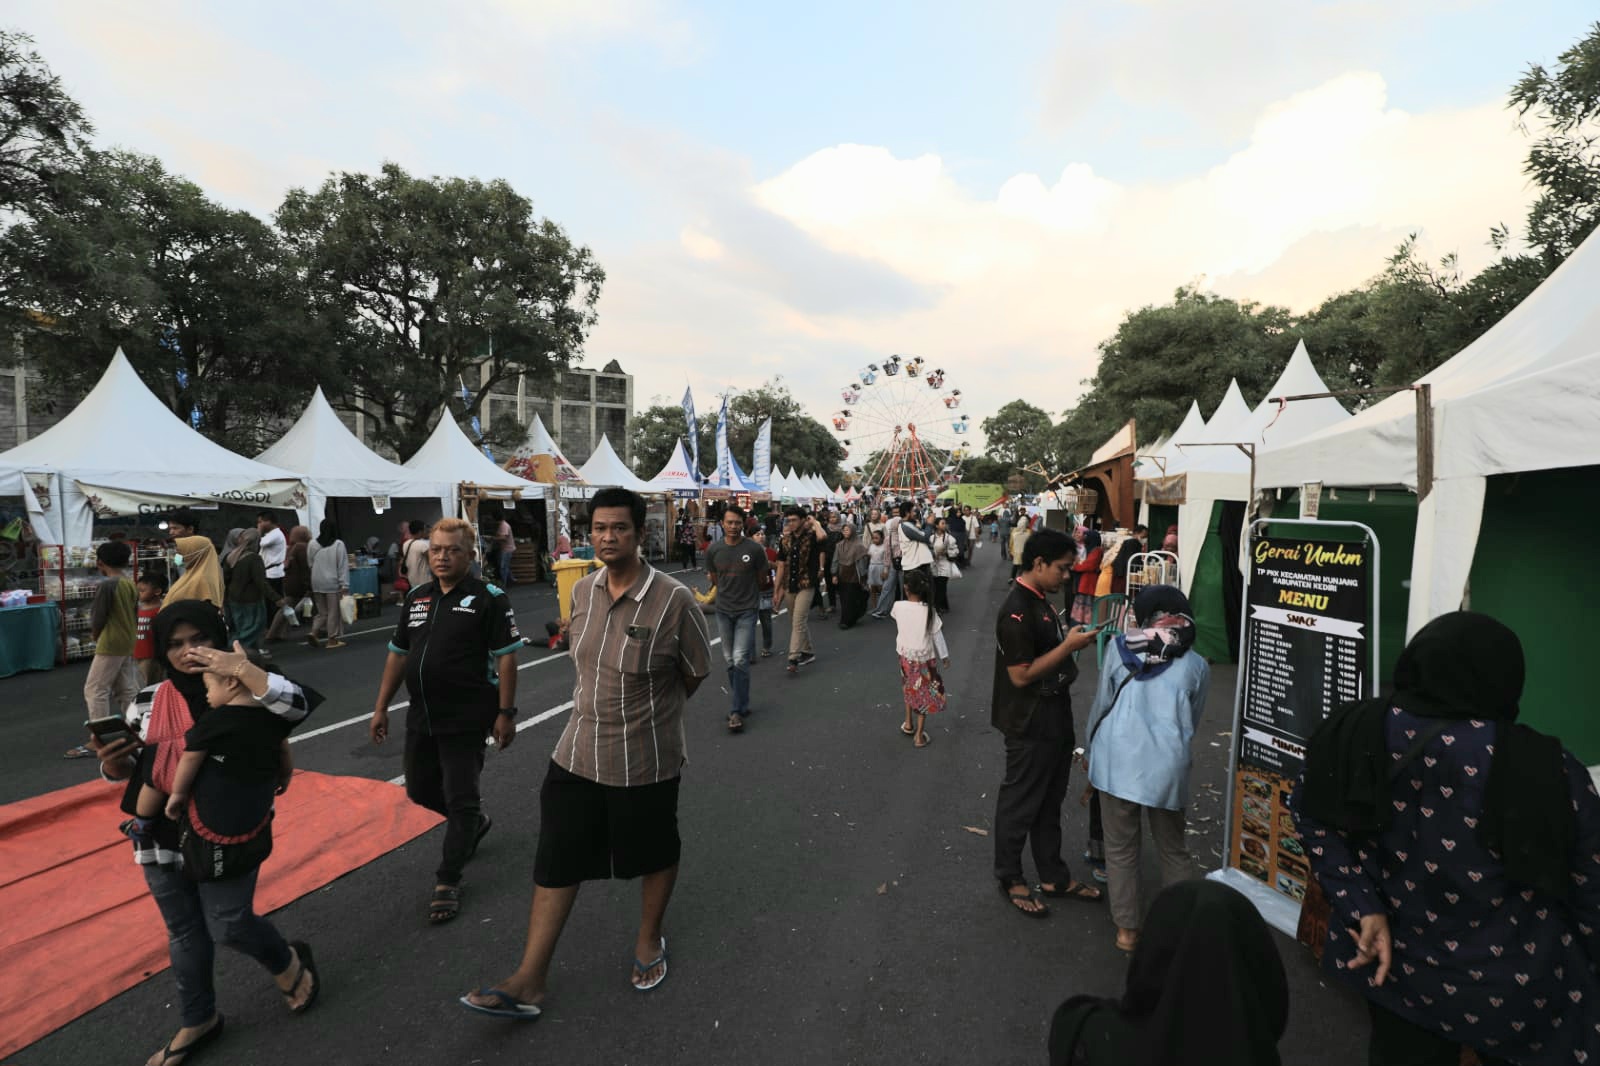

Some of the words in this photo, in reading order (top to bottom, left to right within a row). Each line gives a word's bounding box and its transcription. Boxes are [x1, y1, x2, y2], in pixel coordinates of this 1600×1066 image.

[1256, 541, 1300, 564] Gerai
[1304, 544, 1362, 567] Umkm
[1273, 577, 1312, 588] KABUPATEN
[1313, 583, 1337, 592] KEDIRI
[1280, 571, 1321, 582] KECAMATAN
[1322, 576, 1358, 587] KUNJANG
[1278, 589, 1329, 610] MENU
[1287, 613, 1317, 626] SNACK
